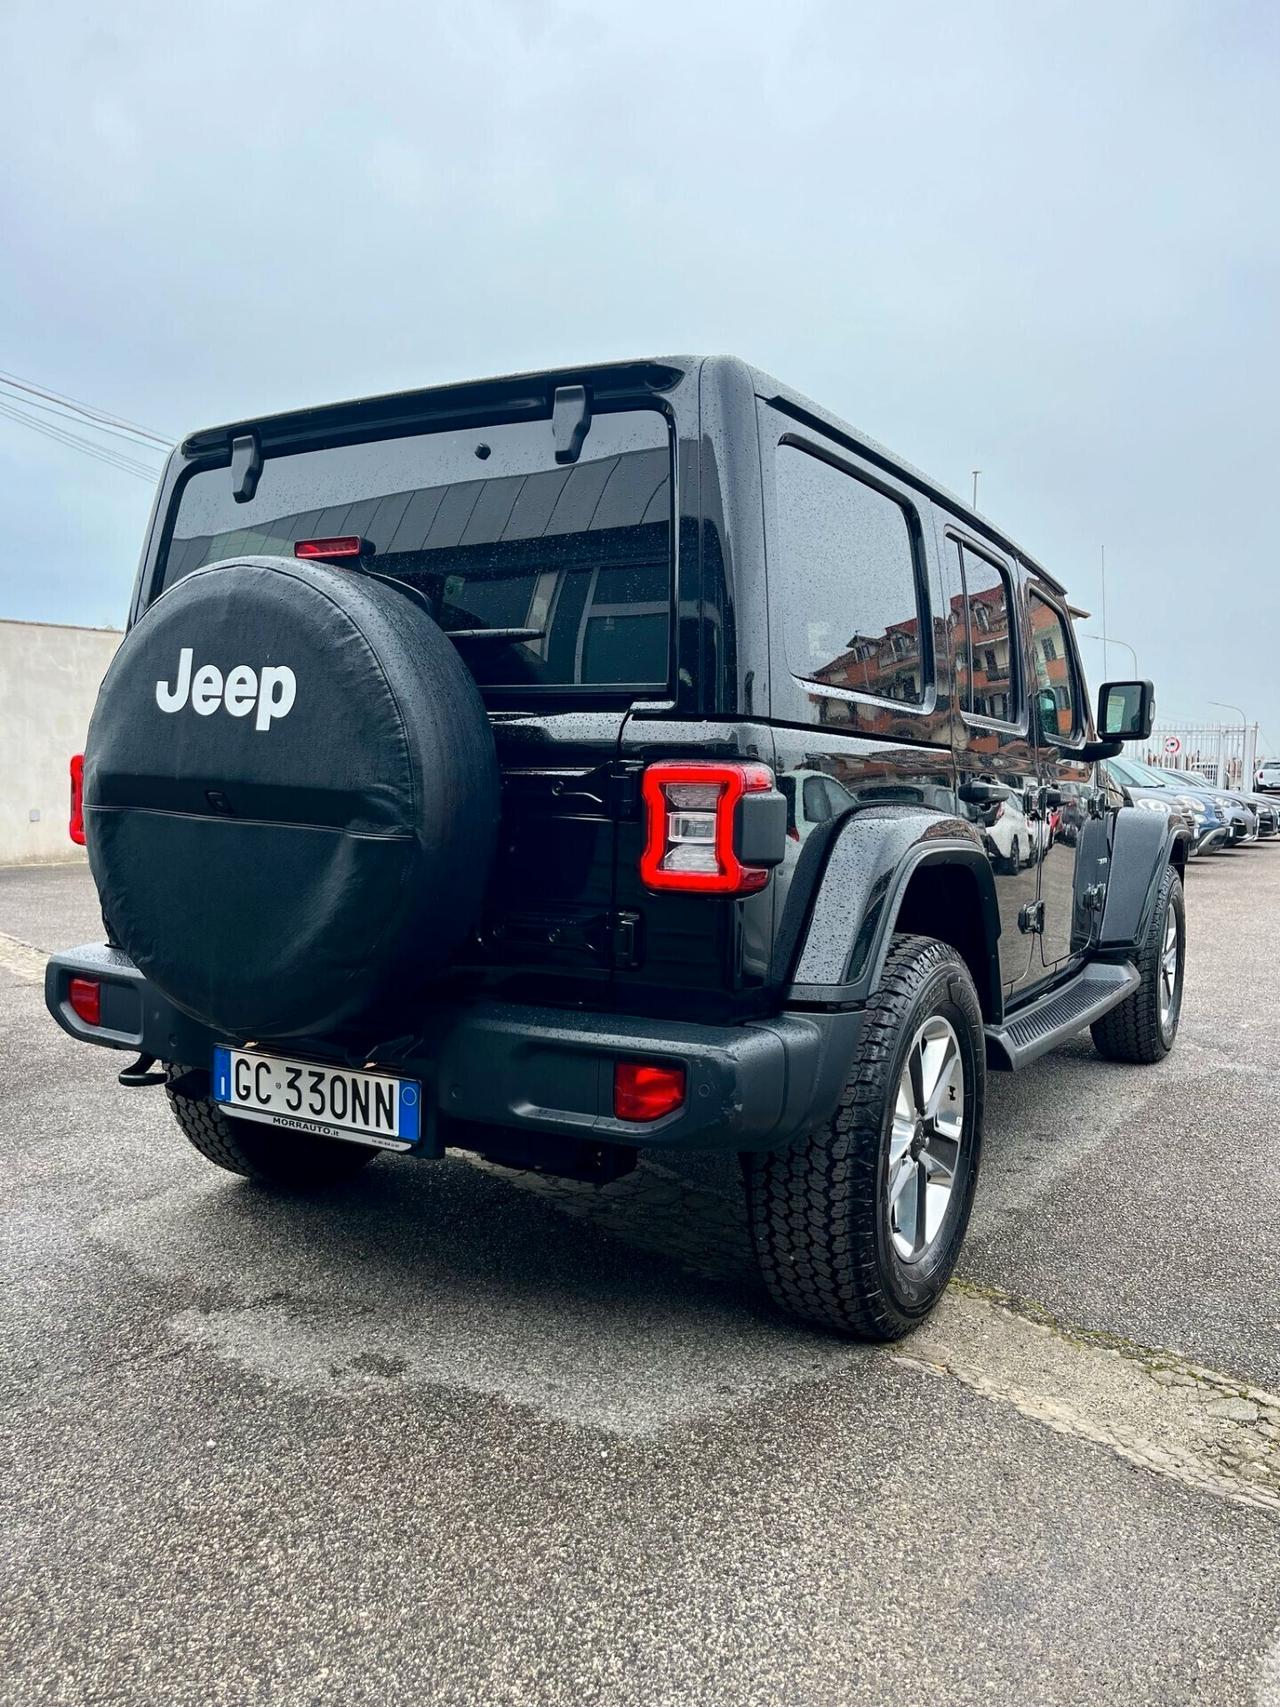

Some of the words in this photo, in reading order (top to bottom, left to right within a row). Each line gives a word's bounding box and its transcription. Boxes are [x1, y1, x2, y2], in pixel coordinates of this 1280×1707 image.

[155, 647, 297, 731] Jeep
[235, 1058, 272, 1105] GC
[285, 1066, 394, 1130] 330NN
[272, 1116, 340, 1137] MORRAUTO.it
